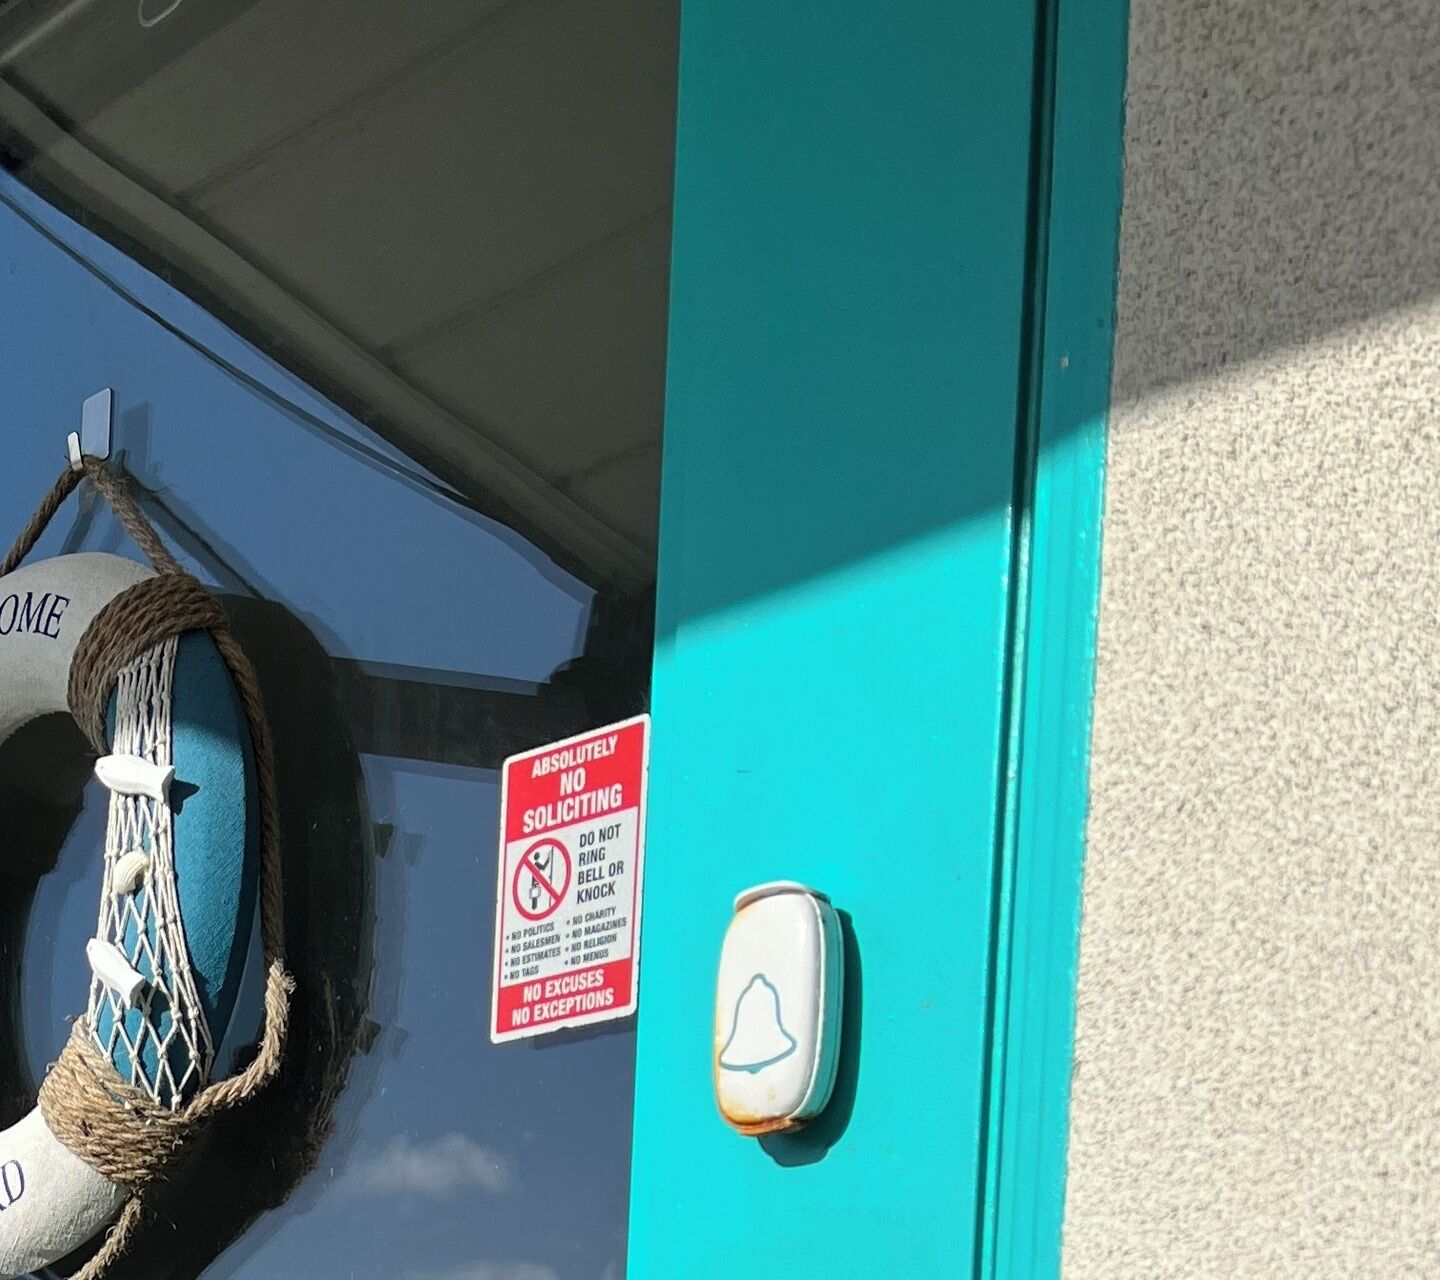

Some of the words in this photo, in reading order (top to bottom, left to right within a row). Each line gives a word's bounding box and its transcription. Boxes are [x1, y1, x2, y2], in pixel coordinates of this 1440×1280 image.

[531, 734, 619, 779] ABSOLUTELY
[560, 767, 586, 797] NO
[522, 783, 623, 834] SOLICITING
[580, 831, 595, 848] DO
[599, 823, 622, 843] NOT
[578, 847, 606, 867] RING
[578, 865, 605, 885] BELL
[608, 861, 624, 877] OR
[576, 881, 616, 904] KNOCK
[572, 914, 583, 926] NO
[585, 907, 617, 923] CHARITY
[511, 929, 522, 941] NO
[523, 922, 555, 938] POLITICS
[571, 927, 583, 939] NO
[584, 917, 627, 936] MAGAZINES
[511, 942, 521, 954] NO
[522, 934, 561, 951] SALESMEN
[571, 940, 582, 952] NO
[583, 933, 617, 950] RELIGION
[510, 955, 521, 967] NO
[522, 947, 561, 965] ESTIMATES
[570, 954, 581, 966] NO
[583, 949, 609, 964] MENUS
[509, 968, 520, 980] NO
[521, 965, 539, 977] TAGS
[523, 983, 542, 1003] NO
[544, 969, 604, 998] EXCUSES
[512, 1006, 530, 1027] NO
[533, 988, 614, 1021] EXCEPTIONS
